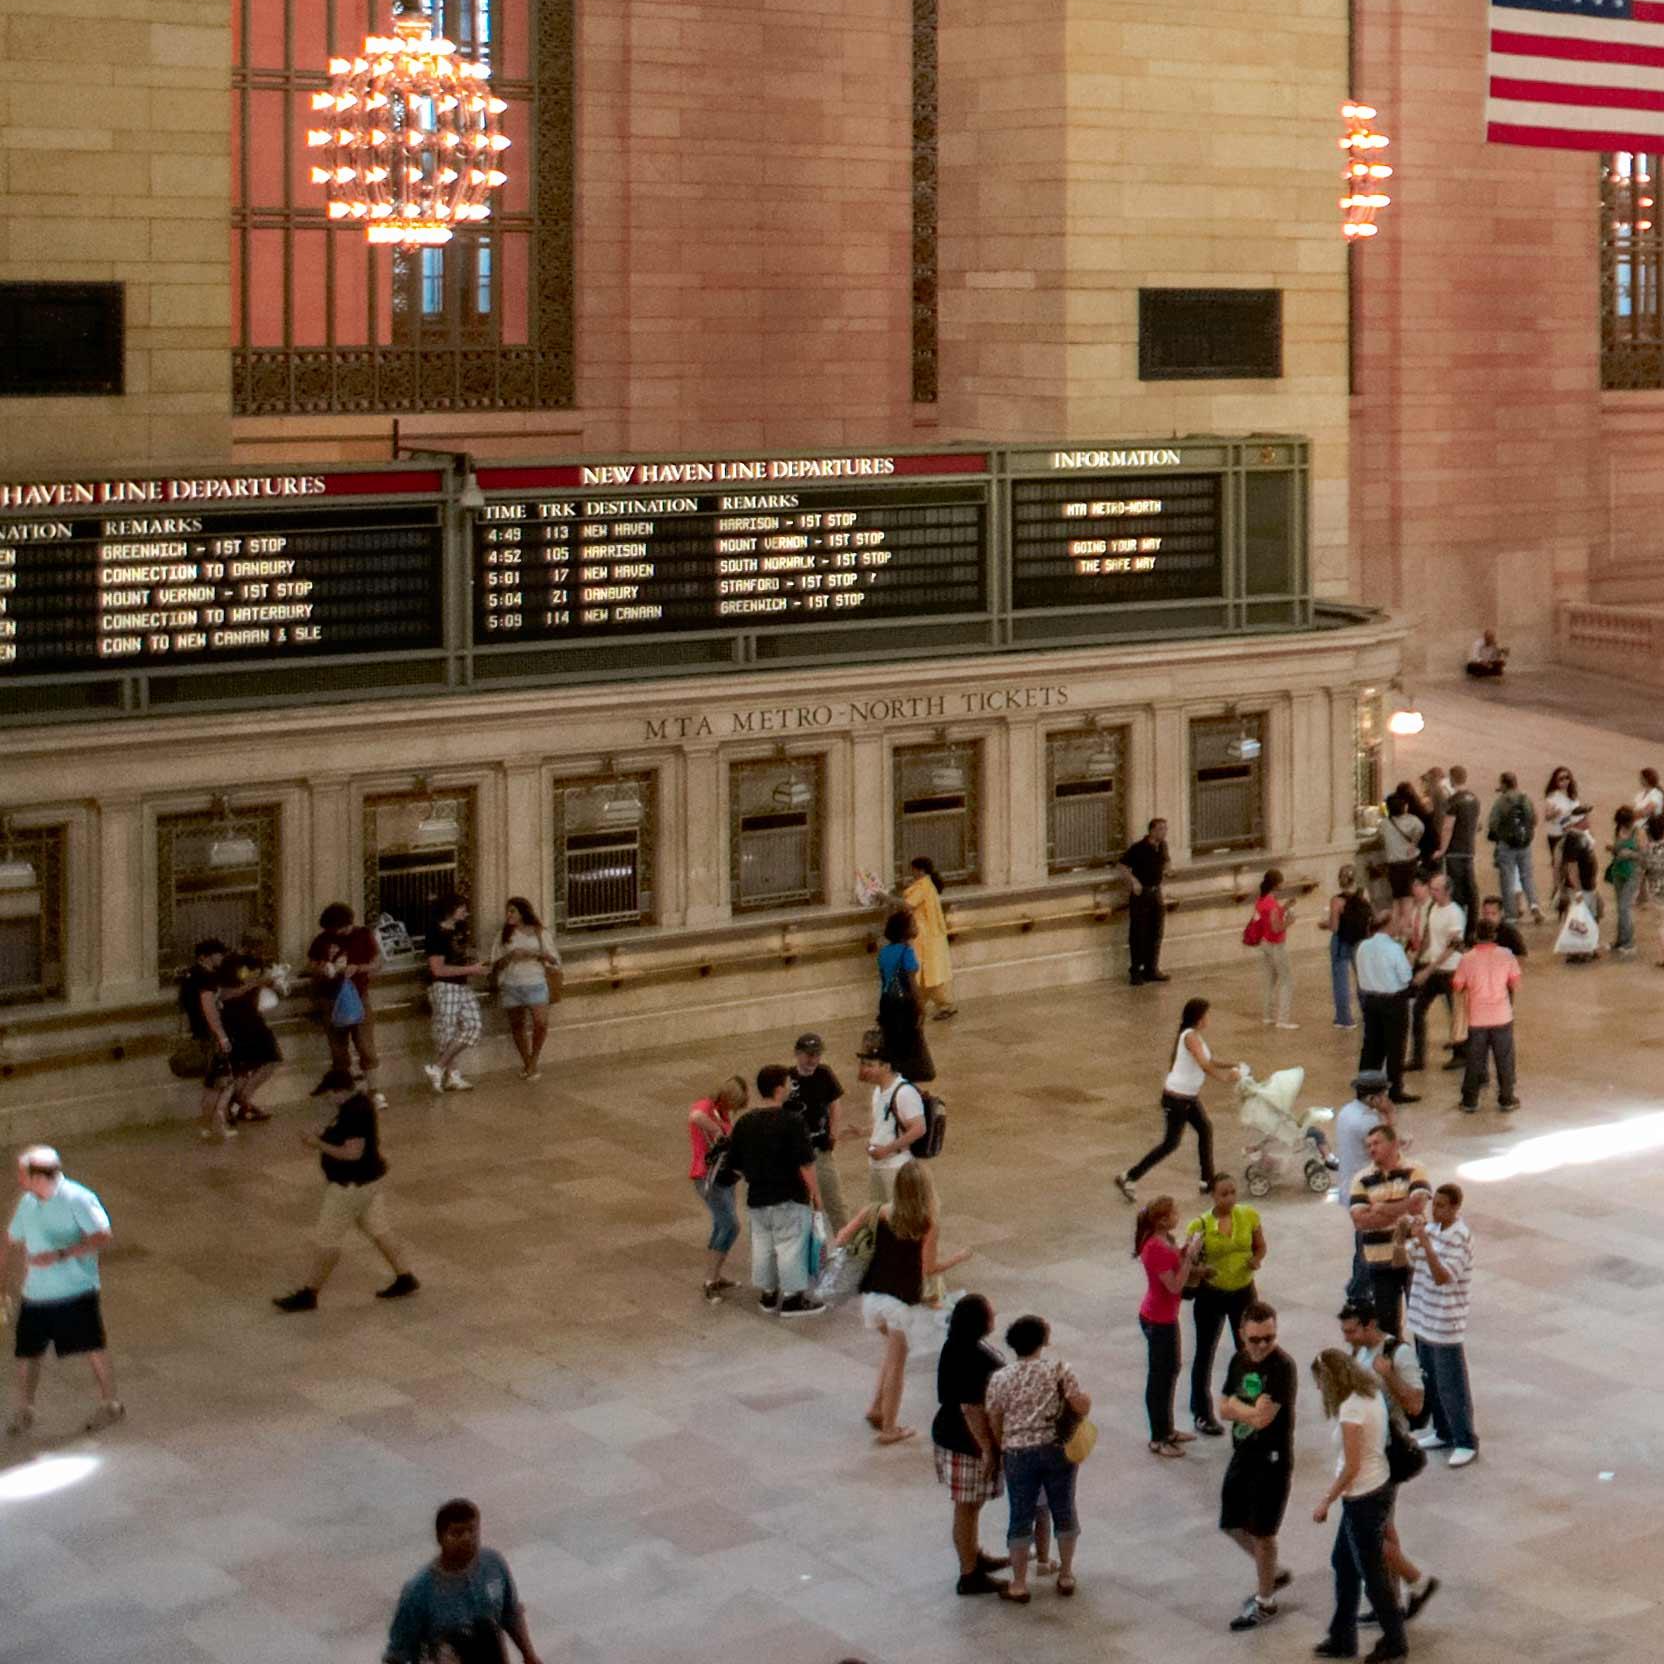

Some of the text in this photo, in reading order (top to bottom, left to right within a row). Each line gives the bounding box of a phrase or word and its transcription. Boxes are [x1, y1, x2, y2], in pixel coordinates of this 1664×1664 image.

[584, 458, 895, 485] NEW HAVEN LINE DEPARTURES
[1055, 450, 1181, 468] INFORMATION
[2, 475, 326, 505] HAVEN LINE DEPARTURES
[485, 494, 799, 519] TIME TRK DESTINATION REMARKS
[1066, 500, 1162, 516] MTA METRO-NORTH
[105, 518, 203, 536] REMARKS
[546, 526, 569, 539] 113
[584, 525, 608, 538] NEW
[614, 522, 654, 536] HAVEN
[720, 517, 779, 532] HARRISON
[801, 514, 822, 528] 1ST
[828, 513, 857, 527] STOP
[103, 542, 187, 561] GREENWICH
[216, 539, 242, 555] 1ST
[250, 537, 287, 553] STOP
[488, 549, 522, 563] 4:52
[546, 547, 569, 561] 105
[584, 544, 647, 559] HARRISON
[720, 538, 757, 553] MOUNT
[764, 536, 808, 550] VERNON
[829, 533, 850, 547] 1ST
[855, 531, 885, 545] STOP
[1073, 538, 1162, 553] GOING YOUR WAY
[103, 564, 197, 584] CONNECTION
[206, 563, 224, 578] TO
[233, 560, 296, 576] DANBURY
[488, 571, 520, 585] 5:01
[553, 569, 569, 582] 17
[584, 566, 608, 579] NEW
[614, 564, 655, 578] HAVEN
[720, 558, 758, 573] SOUTH
[764, 555, 815, 570] NORWALK
[836, 553, 857, 567] 1ST
[863, 551, 892, 565] STOP
[1081, 556, 1156, 572] THE SAFE WAY
[103, 589, 150, 607] MOUNT
[159, 587, 215, 604] VERNON
[243, 583, 269, 599] 1ST
[277, 581, 313, 597] STOP
[489, 592, 522, 607] 5:04
[552, 590, 568, 603] 21
[584, 586, 639, 601] DANBURY
[720, 578, 780, 593] STAMFORD
[802, 574, 823, 588] 1ST
[828, 573, 858, 586] STOP
[103, 610, 197, 631] CONNECTION
[206, 608, 225, 624] TO
[233, 604, 314, 622] WATERBURY
[546, 611, 570, 625] 114
[585, 608, 609, 622] NEW
[616, 605, 662, 620] CANAAN
[720, 598, 787, 614] GREENWICH
[808, 595, 830, 609] 1ST
[835, 593, 865, 607] STOP
[103, 637, 142, 655] CONN
[152, 635, 169, 651] TO
[178, 633, 207, 649] NEW
[214, 629, 270, 646] CANAAN
[277, 628, 287, 643] &
[295, 625, 322, 641] SLE
[645, 716, 712, 741] MTA
[960, 685, 1069, 715] TICKETS
